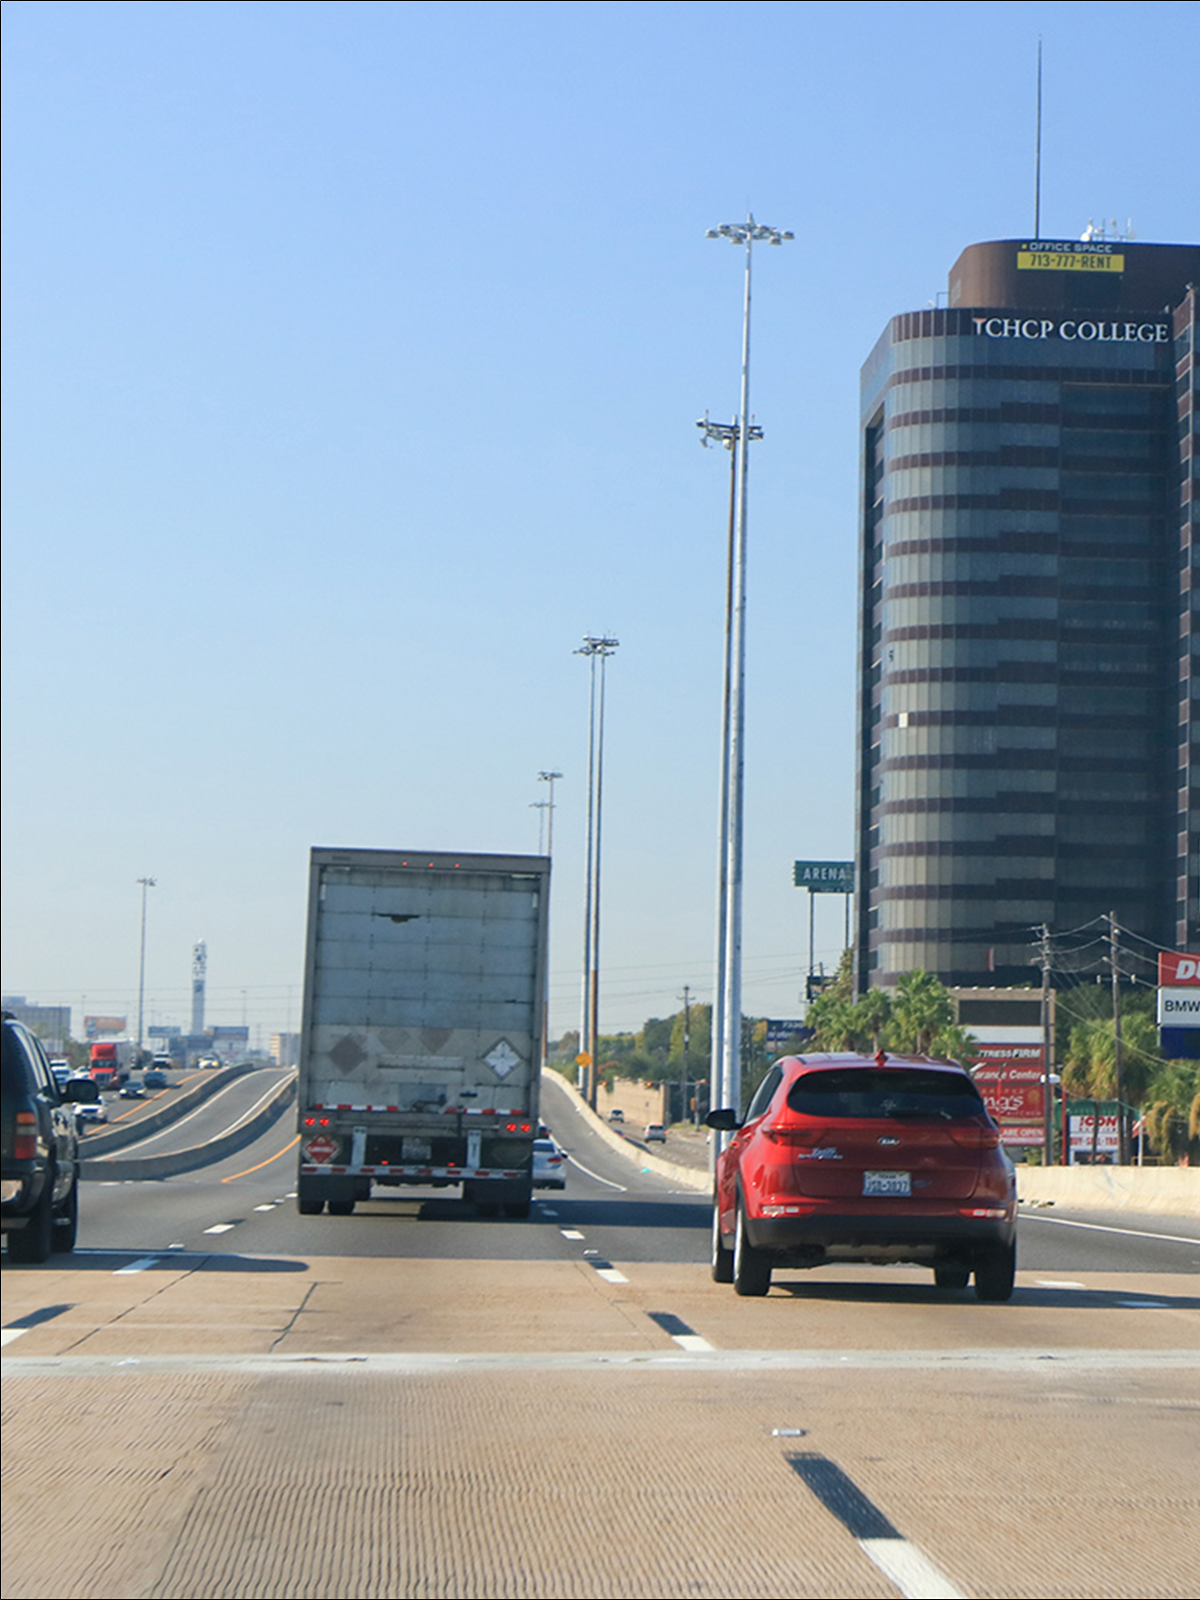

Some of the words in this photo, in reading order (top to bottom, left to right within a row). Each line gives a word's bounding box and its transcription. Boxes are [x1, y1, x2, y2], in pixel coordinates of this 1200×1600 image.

[1029, 242, 1071, 251] OFFICE
[1074, 244, 1113, 253] SPACE
[1030, 254, 1113, 269] 713-777-RENT
[1059, 321, 1169, 343] COLLEGE
[803, 867, 846, 880] ARENA
[1164, 999, 1200, 1012] BMW
[1009, 1069, 1040, 1079] Center
[1080, 1116, 1118, 1127] ICON
